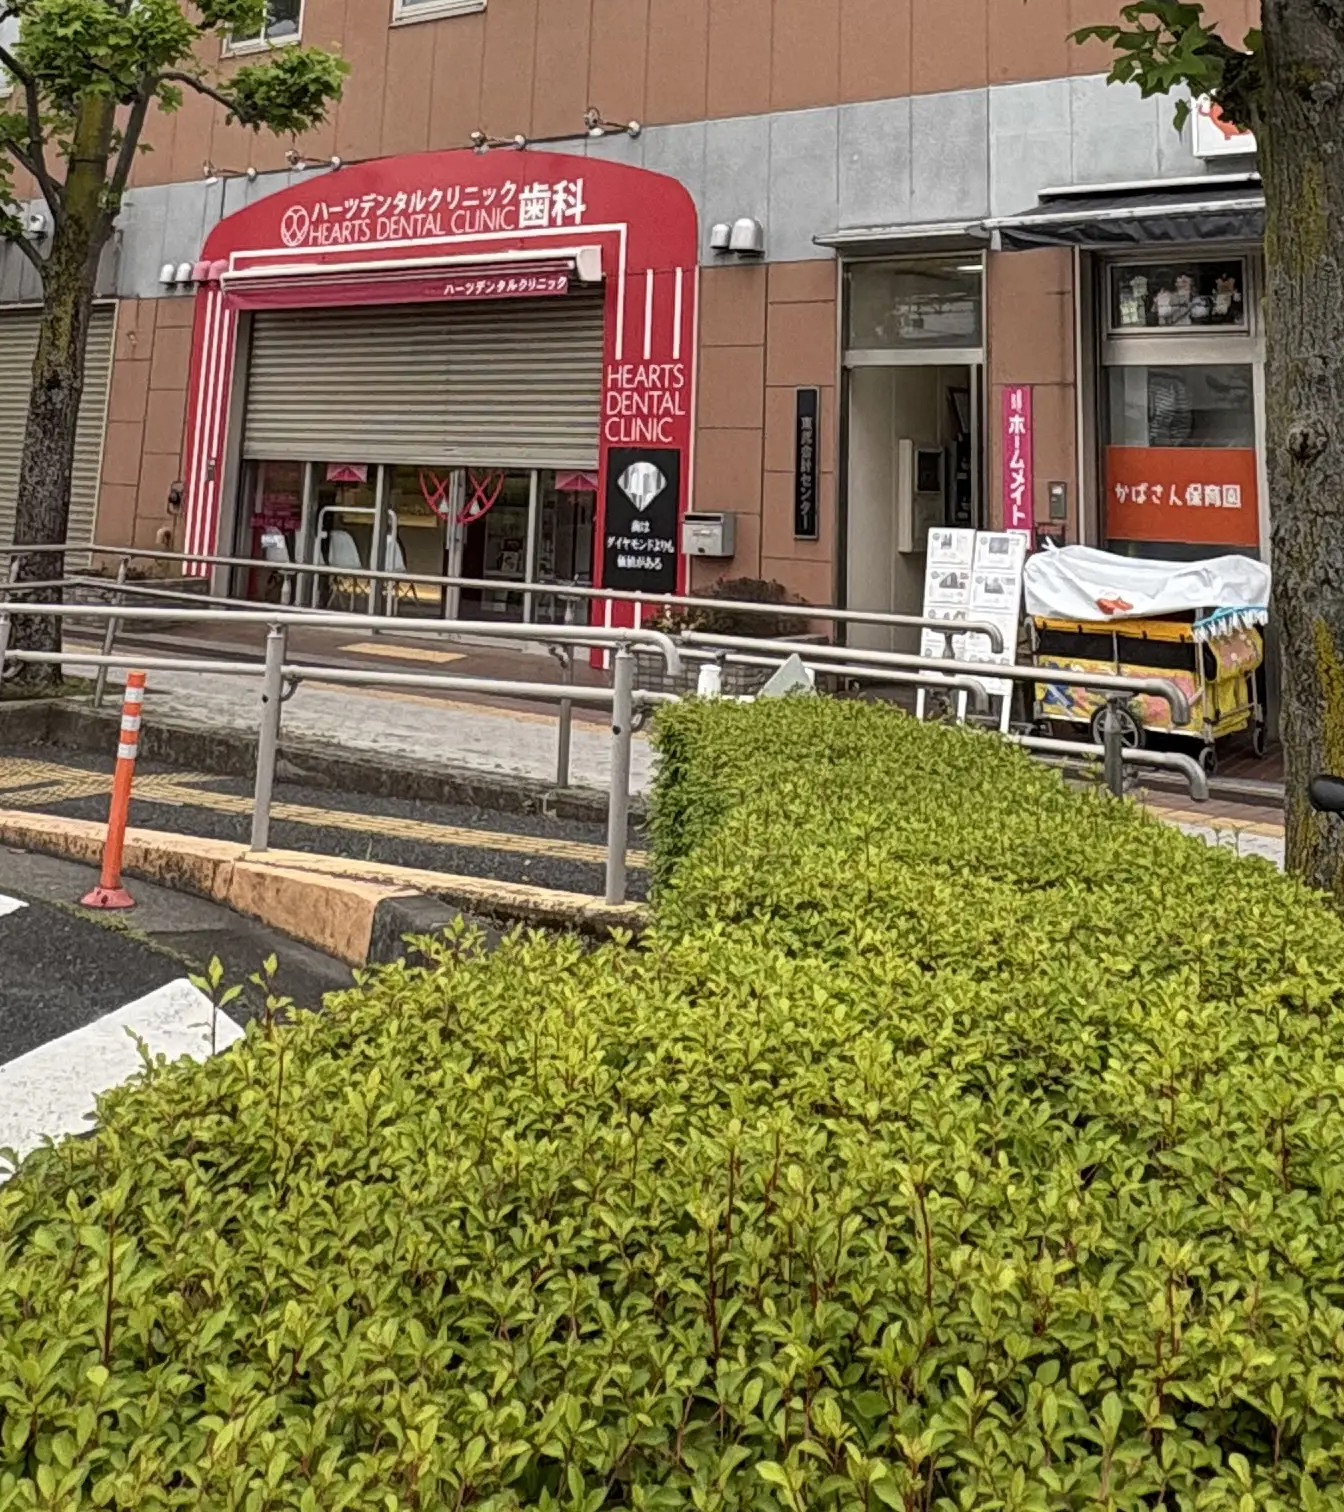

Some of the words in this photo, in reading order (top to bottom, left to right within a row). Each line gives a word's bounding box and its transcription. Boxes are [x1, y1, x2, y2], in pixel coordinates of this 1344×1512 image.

[310, 180, 518, 222] ハーツデンタルクリニック
[518, 177, 587, 229] 歯科
[308, 218, 371, 246] HEARTS
[376, 211, 446, 240] DENTAL
[450, 206, 516, 235] CLINIC
[442, 275, 568, 296] ハーツデンタルクリニック
[606, 363, 685, 389] HEARTS
[606, 391, 686, 416] DENTAL
[605, 417, 674, 443] CLINIC
[1008, 413, 1026, 527] ホームメイト
[1114, 482, 1242, 508] かばさん保育園
